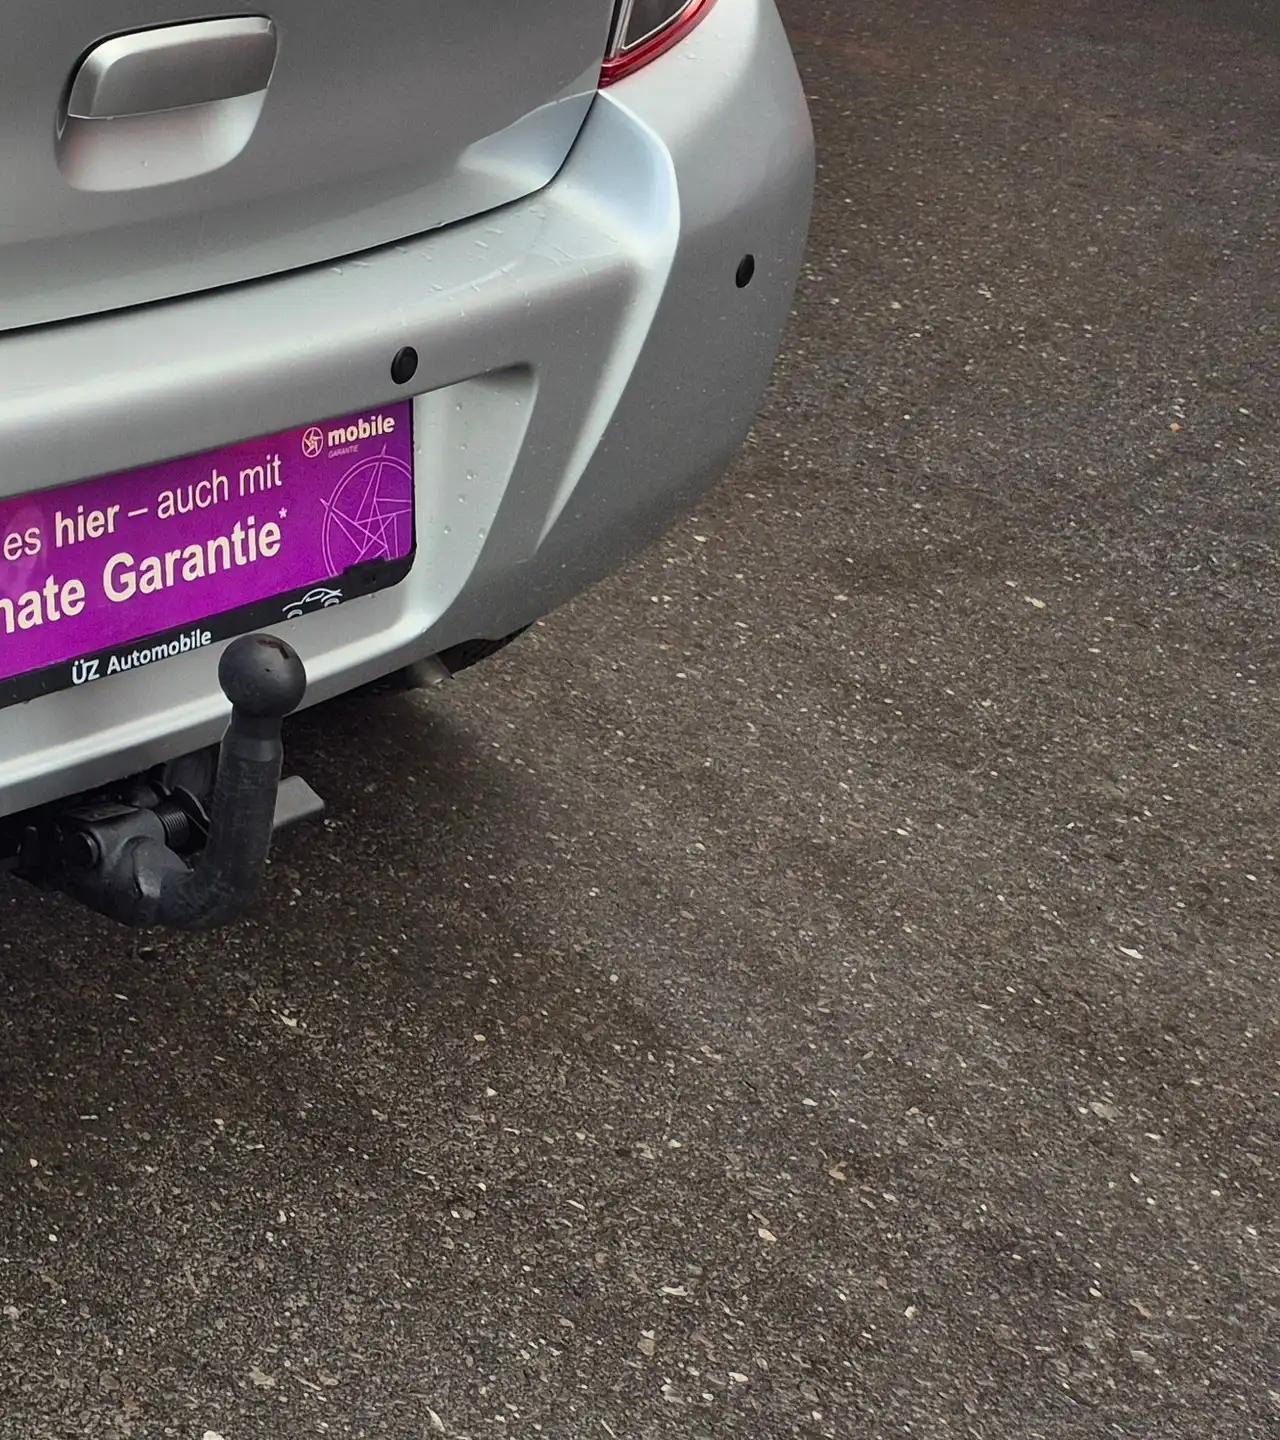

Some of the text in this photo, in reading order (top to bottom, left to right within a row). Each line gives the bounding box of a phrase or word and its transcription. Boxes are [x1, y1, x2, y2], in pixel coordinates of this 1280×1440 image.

[328, 414, 395, 446] mobile
[328, 444, 359, 458] GARANTIE
[3, 527, 41, 561] es
[55, 505, 120, 548] hier
[157, 469, 229, 519] auch
[239, 454, 282, 497] mit
[71, 628, 212, 685] ÜZ Automobile
